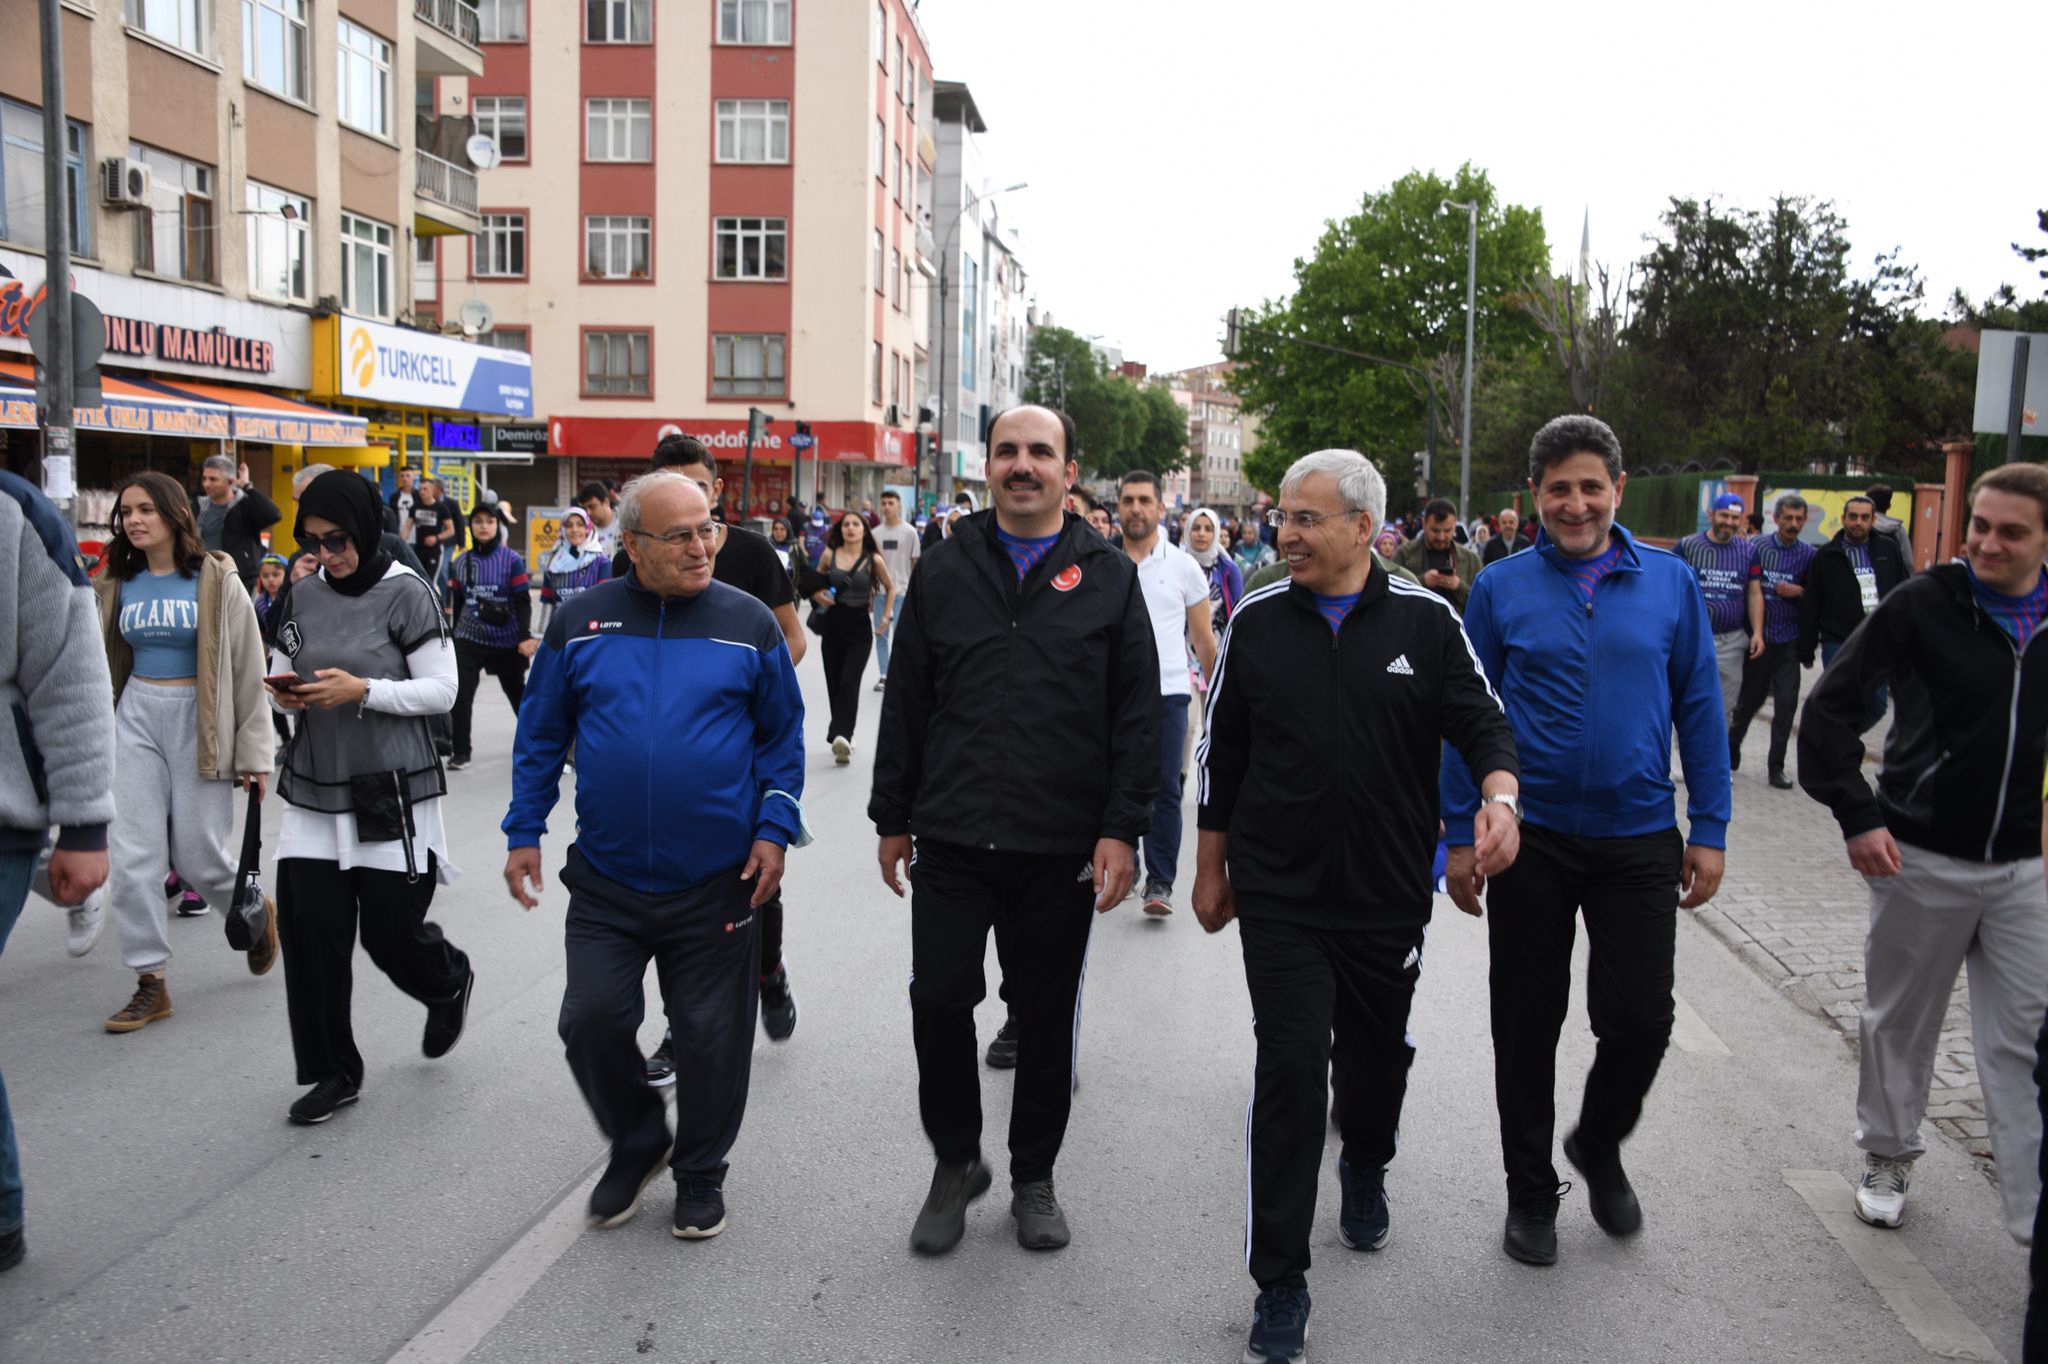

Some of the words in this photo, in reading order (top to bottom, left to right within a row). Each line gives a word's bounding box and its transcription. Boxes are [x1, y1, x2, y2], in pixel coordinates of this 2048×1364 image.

[161, 325, 275, 373] MAMÜLLER
[378, 345, 457, 387] TURKCELL
[600, 621, 623, 629] LOTTO
[1386, 665, 1414, 676] adidas
